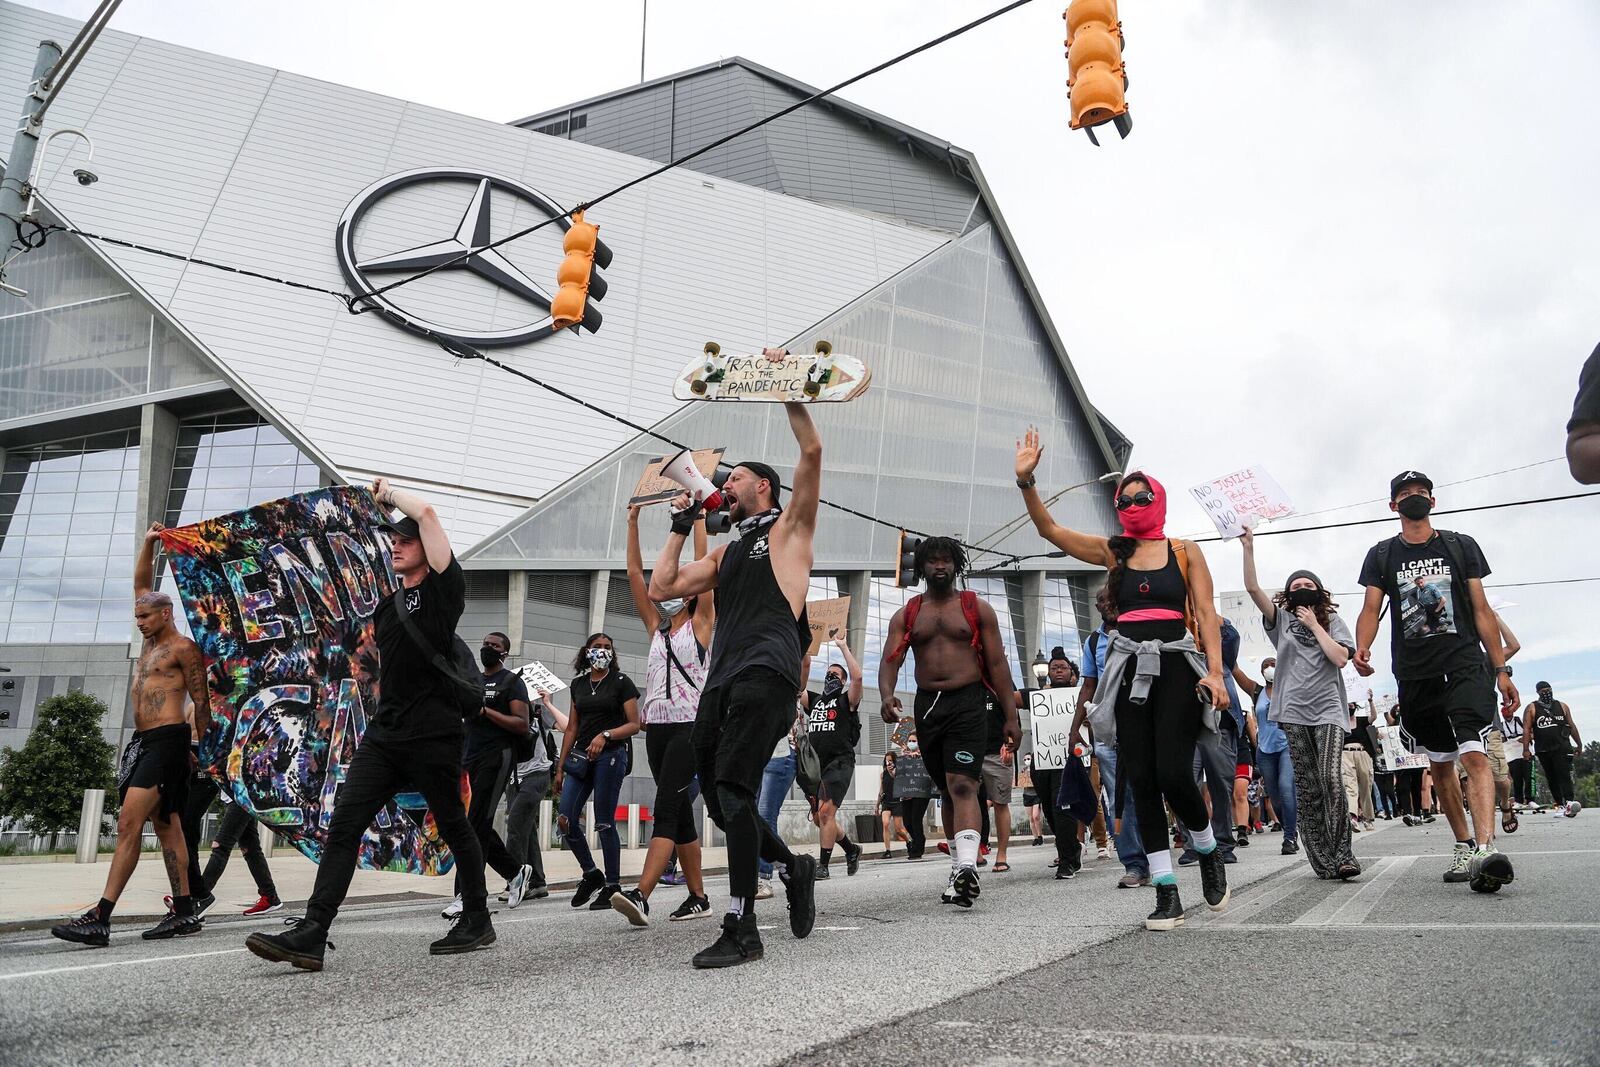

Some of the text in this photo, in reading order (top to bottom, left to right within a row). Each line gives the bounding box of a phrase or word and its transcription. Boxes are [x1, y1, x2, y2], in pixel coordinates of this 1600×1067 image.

[728, 357, 798, 372] RACISM
[744, 371, 754, 379] IS
[728, 379, 801, 394] PANDEMIC
[1402, 471, 1416, 480] A
[1194, 469, 1254, 500] NO JUSTICE
[1205, 499, 1222, 511] NO
[1217, 496, 1268, 530] NO RACIST
[1401, 558, 1444, 571] I CAN'T
[1396, 566, 1451, 580] BREATHE
[809, 721, 836, 732] ATTER
[1035, 722, 1067, 748] Live
[1037, 747, 1069, 767] Mat
